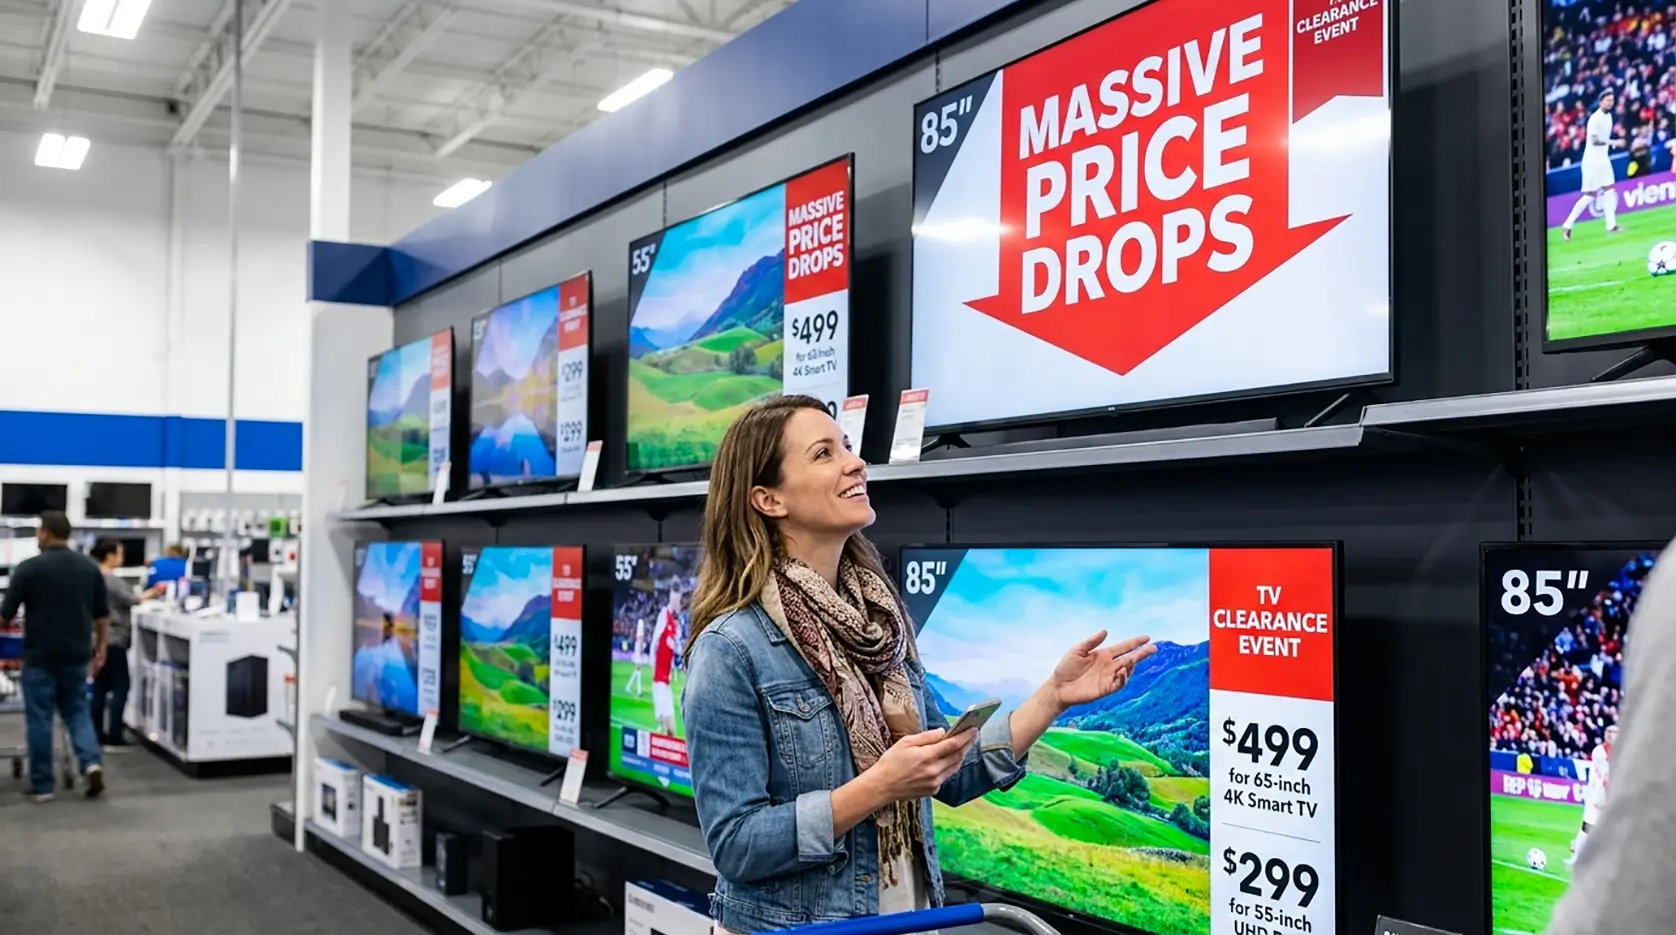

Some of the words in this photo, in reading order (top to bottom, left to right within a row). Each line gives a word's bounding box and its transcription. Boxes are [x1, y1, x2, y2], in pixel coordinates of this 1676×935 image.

[1314, 16, 1359, 45] EVENT
[1019, 13, 1264, 160] MASSIVE
[920, 94, 973, 154] 85"
[1026, 92, 1250, 240] PRICE
[788, 190, 845, 228] MASSIVE
[788, 212, 844, 256] PRICE
[788, 243, 844, 280] DROPS
[1021, 193, 1254, 315] DROPS
[792, 309, 839, 345] $499
[826, 358, 838, 372] TV
[905, 560, 947, 595] 85"
[1256, 585, 1282, 605] TV
[1501, 568, 1589, 617] 85"
[1213, 608, 1328, 634] CLEARANCE
[1239, 635, 1301, 658] EVENT
[1222, 716, 1319, 771] $499
[1229, 767, 1250, 785] for
[1254, 771, 1311, 796] 65-inch
[1224, 788, 1245, 806] 4K
[1248, 792, 1293, 815] Smart
[1296, 799, 1318, 818] TV
[1222, 846, 1320, 908] $299
[1229, 897, 1251, 917] for
[1255, 904, 1312, 934] 55-inch
